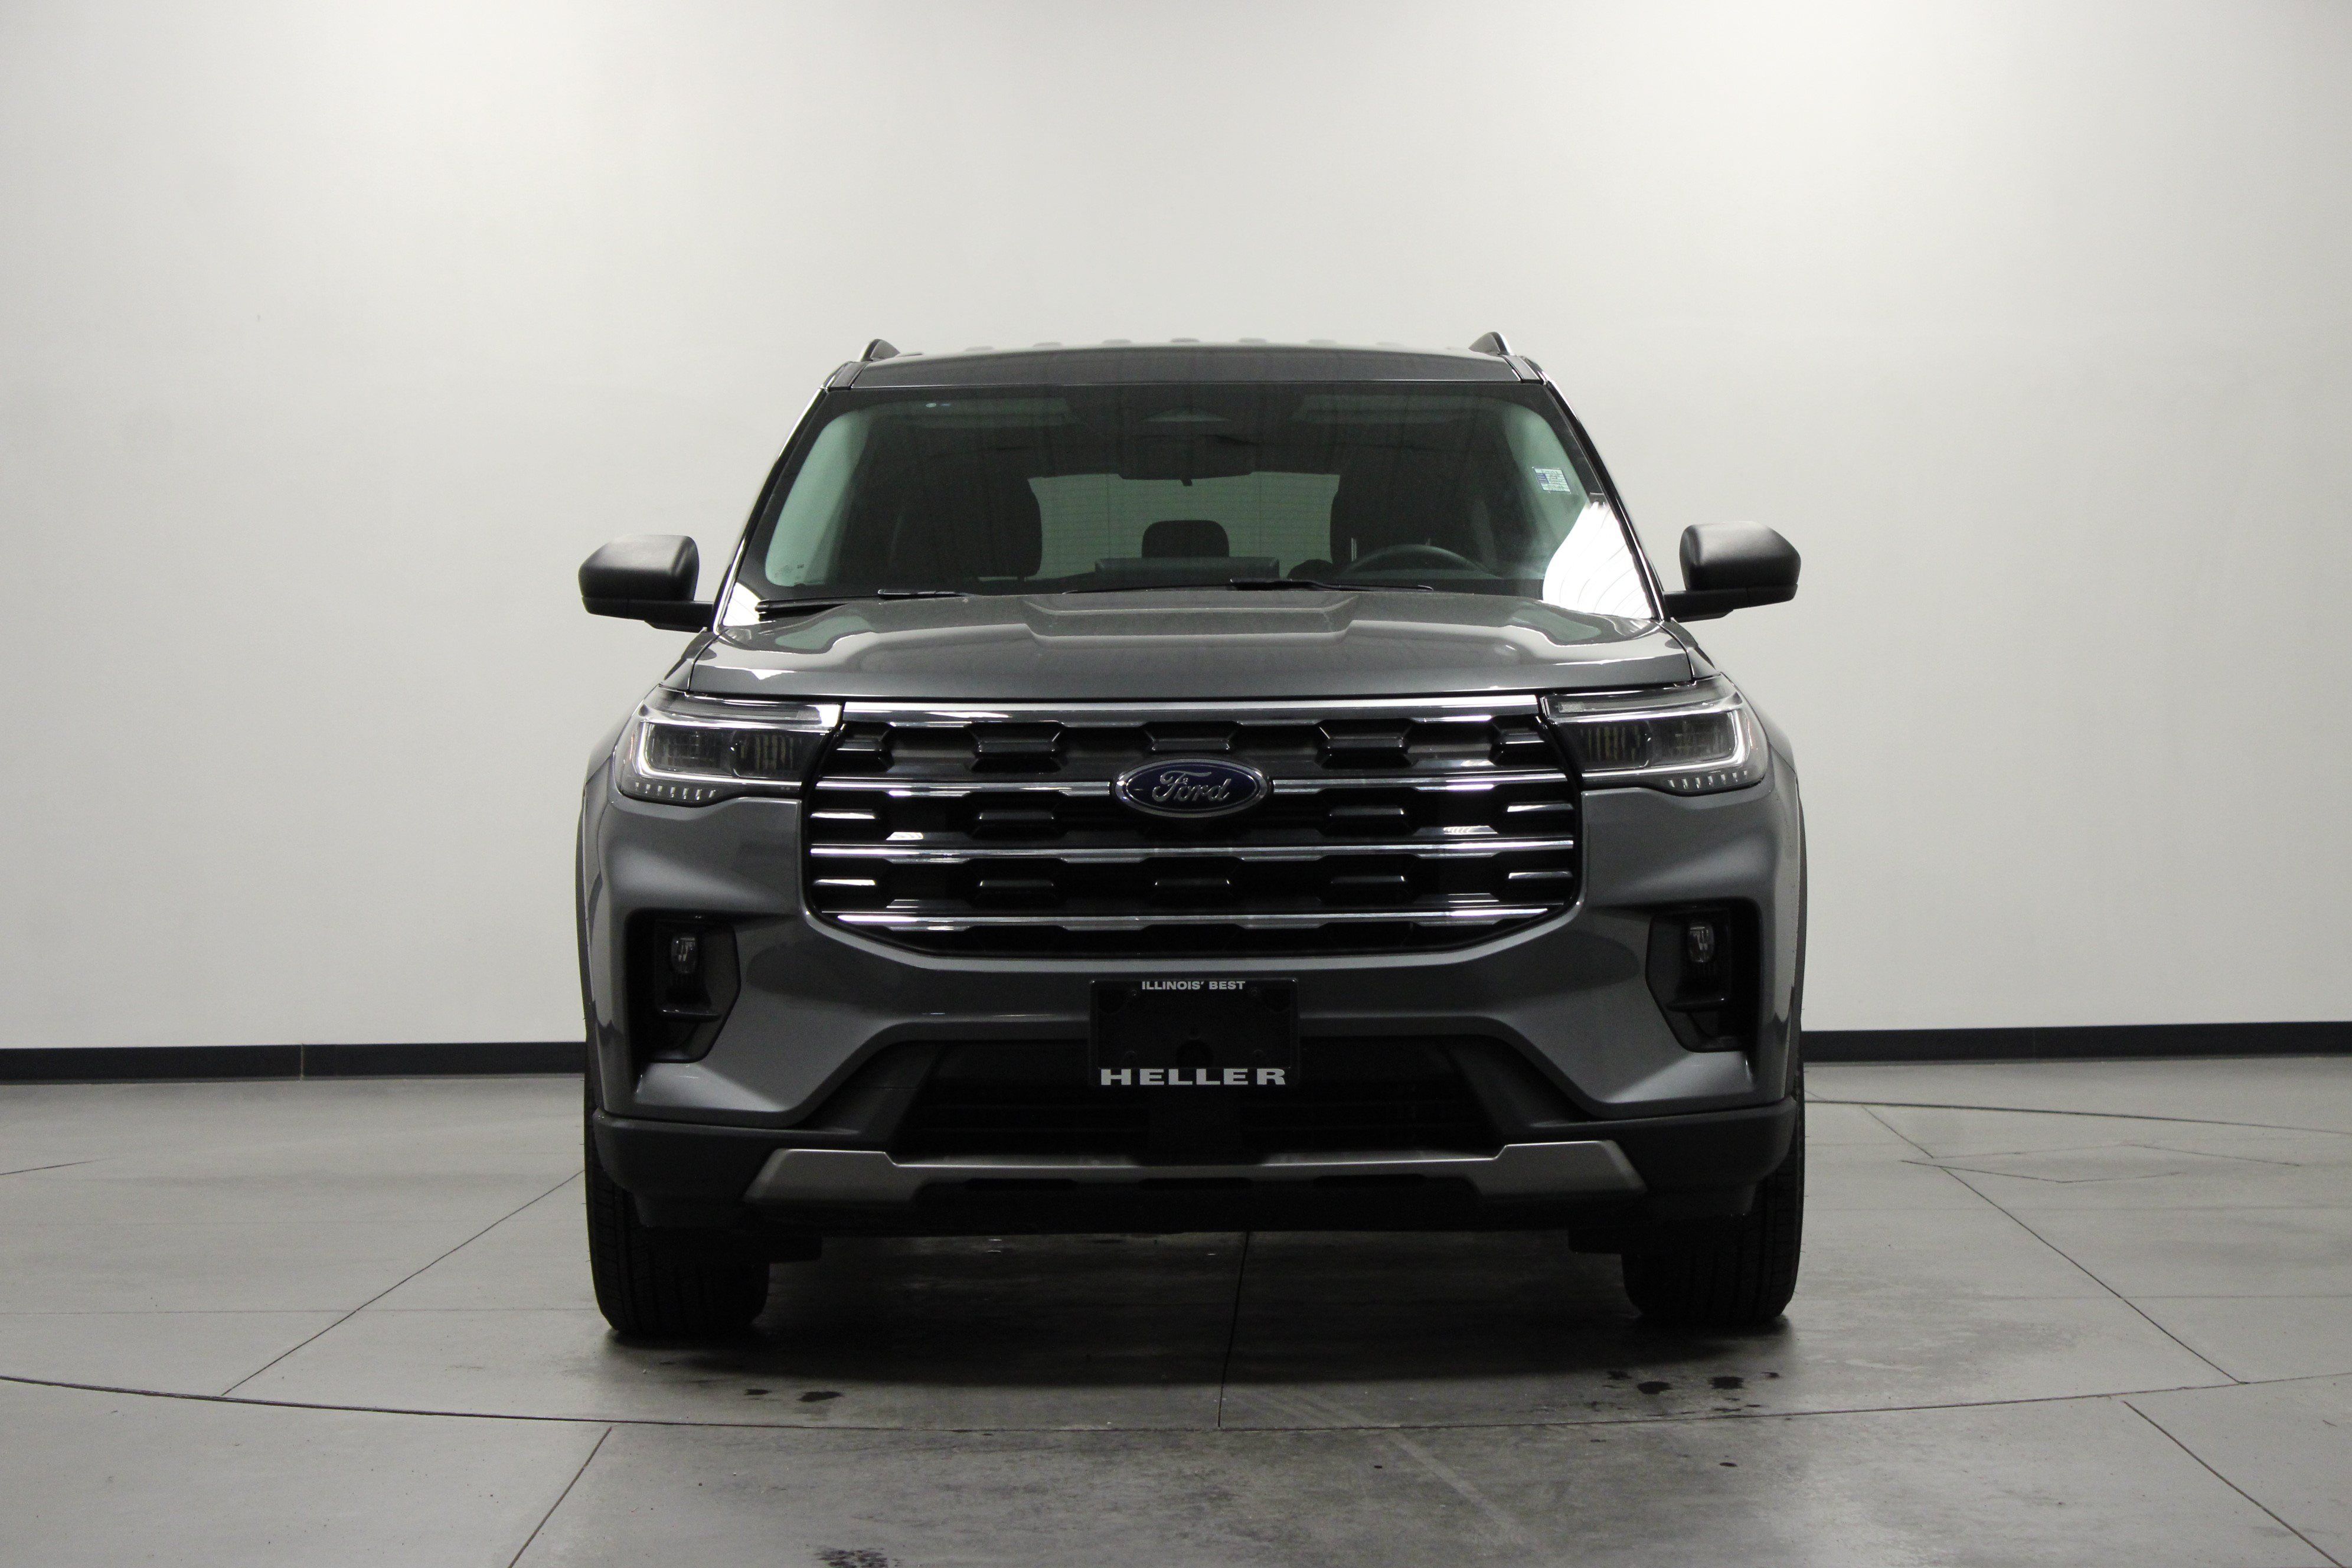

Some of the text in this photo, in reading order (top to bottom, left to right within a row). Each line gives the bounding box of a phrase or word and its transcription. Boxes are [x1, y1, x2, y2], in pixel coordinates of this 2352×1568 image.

[1152, 770, 1232, 802] Ford
[1142, 981, 1246, 990] ILLINOIS' BEST
[1100, 1068, 1286, 1086] HELLER
